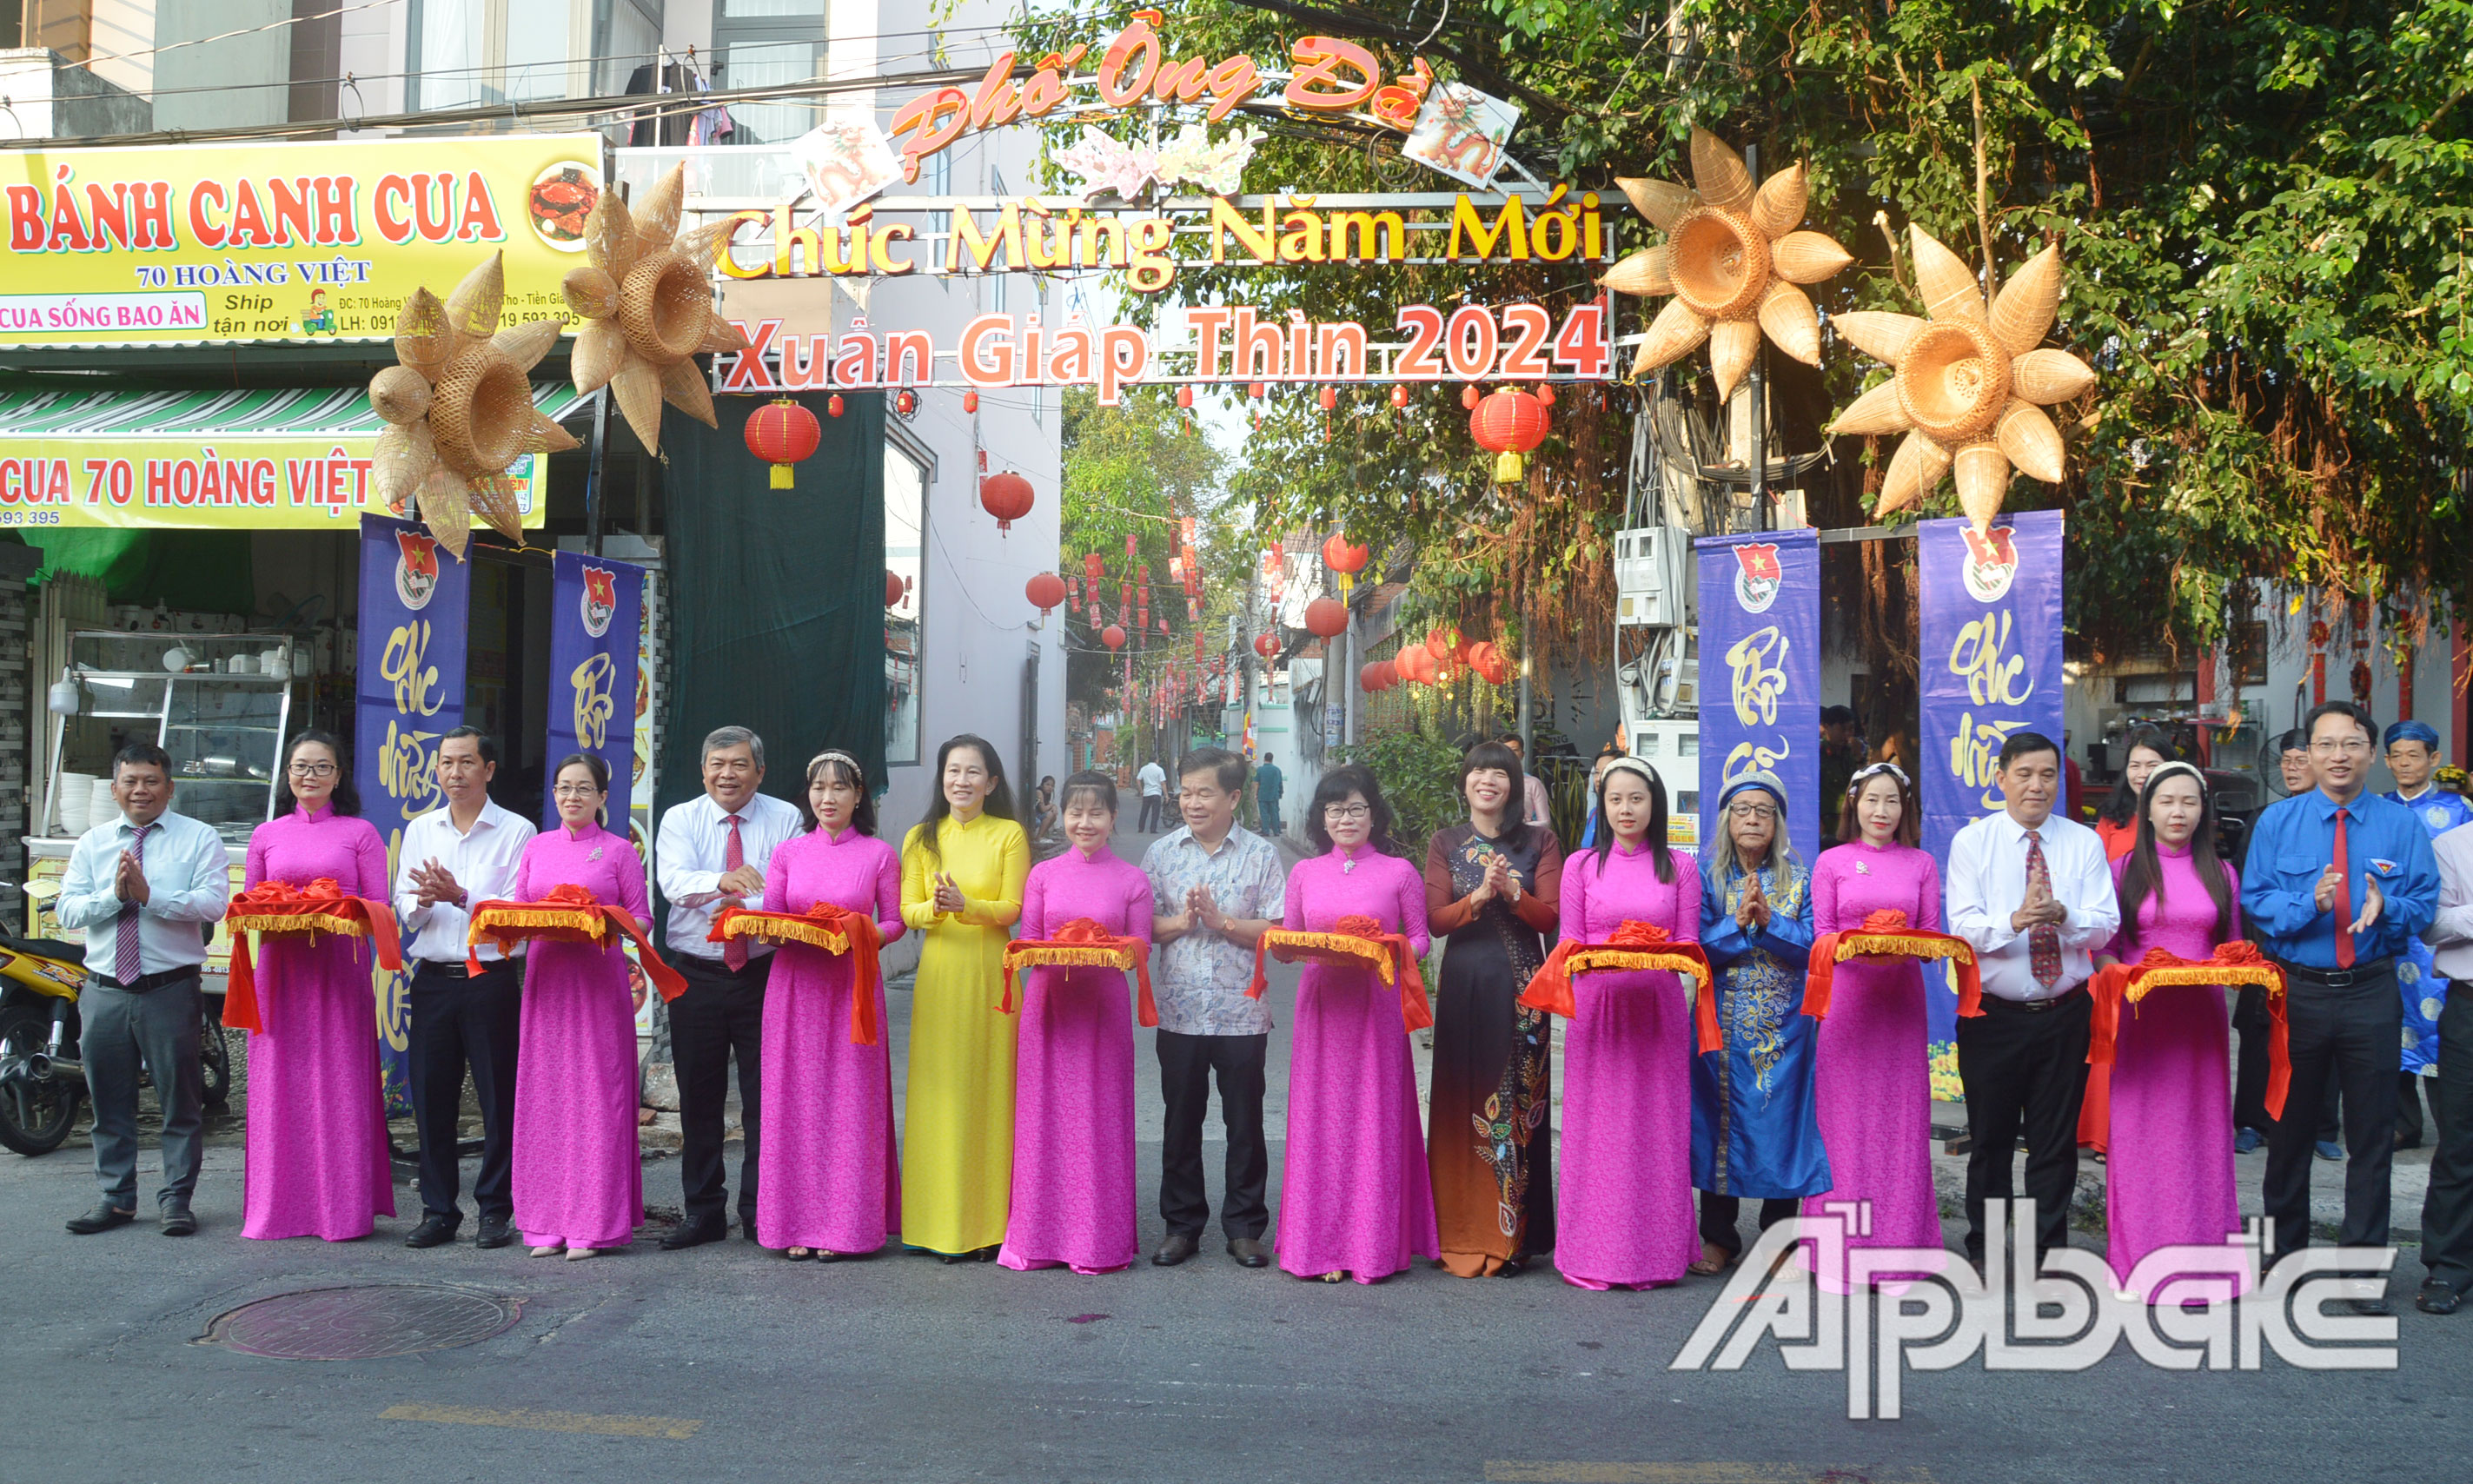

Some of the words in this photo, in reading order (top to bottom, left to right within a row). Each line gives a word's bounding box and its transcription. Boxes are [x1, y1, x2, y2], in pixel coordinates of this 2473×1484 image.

[890, 43, 1086, 185] Phố
[1097, 9, 1263, 124] Ông
[6, 163, 176, 252] BÁNH
[189, 176, 360, 248] CANH
[374, 171, 505, 243] CUA
[713, 202, 915, 278] Chúc
[944, 196, 1176, 294] Mừng
[1211, 195, 1405, 264] Năm
[1448, 183, 1601, 262] Mới
[136, 267, 166, 288] 70
[175, 259, 289, 287] HOÀNG
[296, 256, 371, 288] VIỆT
[0, 308, 43, 328] CUA
[49, 298, 110, 328] SỐNG
[118, 305, 162, 326] BAO
[169, 301, 200, 325] ĂN
[225, 295, 273, 313] Ship
[340, 297, 356, 309] ĐC:
[359, 297, 369, 308] 70
[549, 292, 566, 304] Gia
[214, 318, 245, 336] tận
[254, 316, 288, 333] nơi
[341, 315, 365, 330] LH:
[371, 315, 397, 330] 091
[719, 315, 934, 393] Xuân
[958, 311, 1150, 406] Giáp
[1183, 305, 1367, 382] Thìn
[1394, 303, 1609, 382] 2024
[0, 459, 70, 504] CUA
[86, 460, 133, 504] 70
[148, 448, 275, 505] HOÀNG
[288, 447, 372, 515] VIỆT
[0, 511, 23, 524] 93
[29, 511, 60, 524] 395
